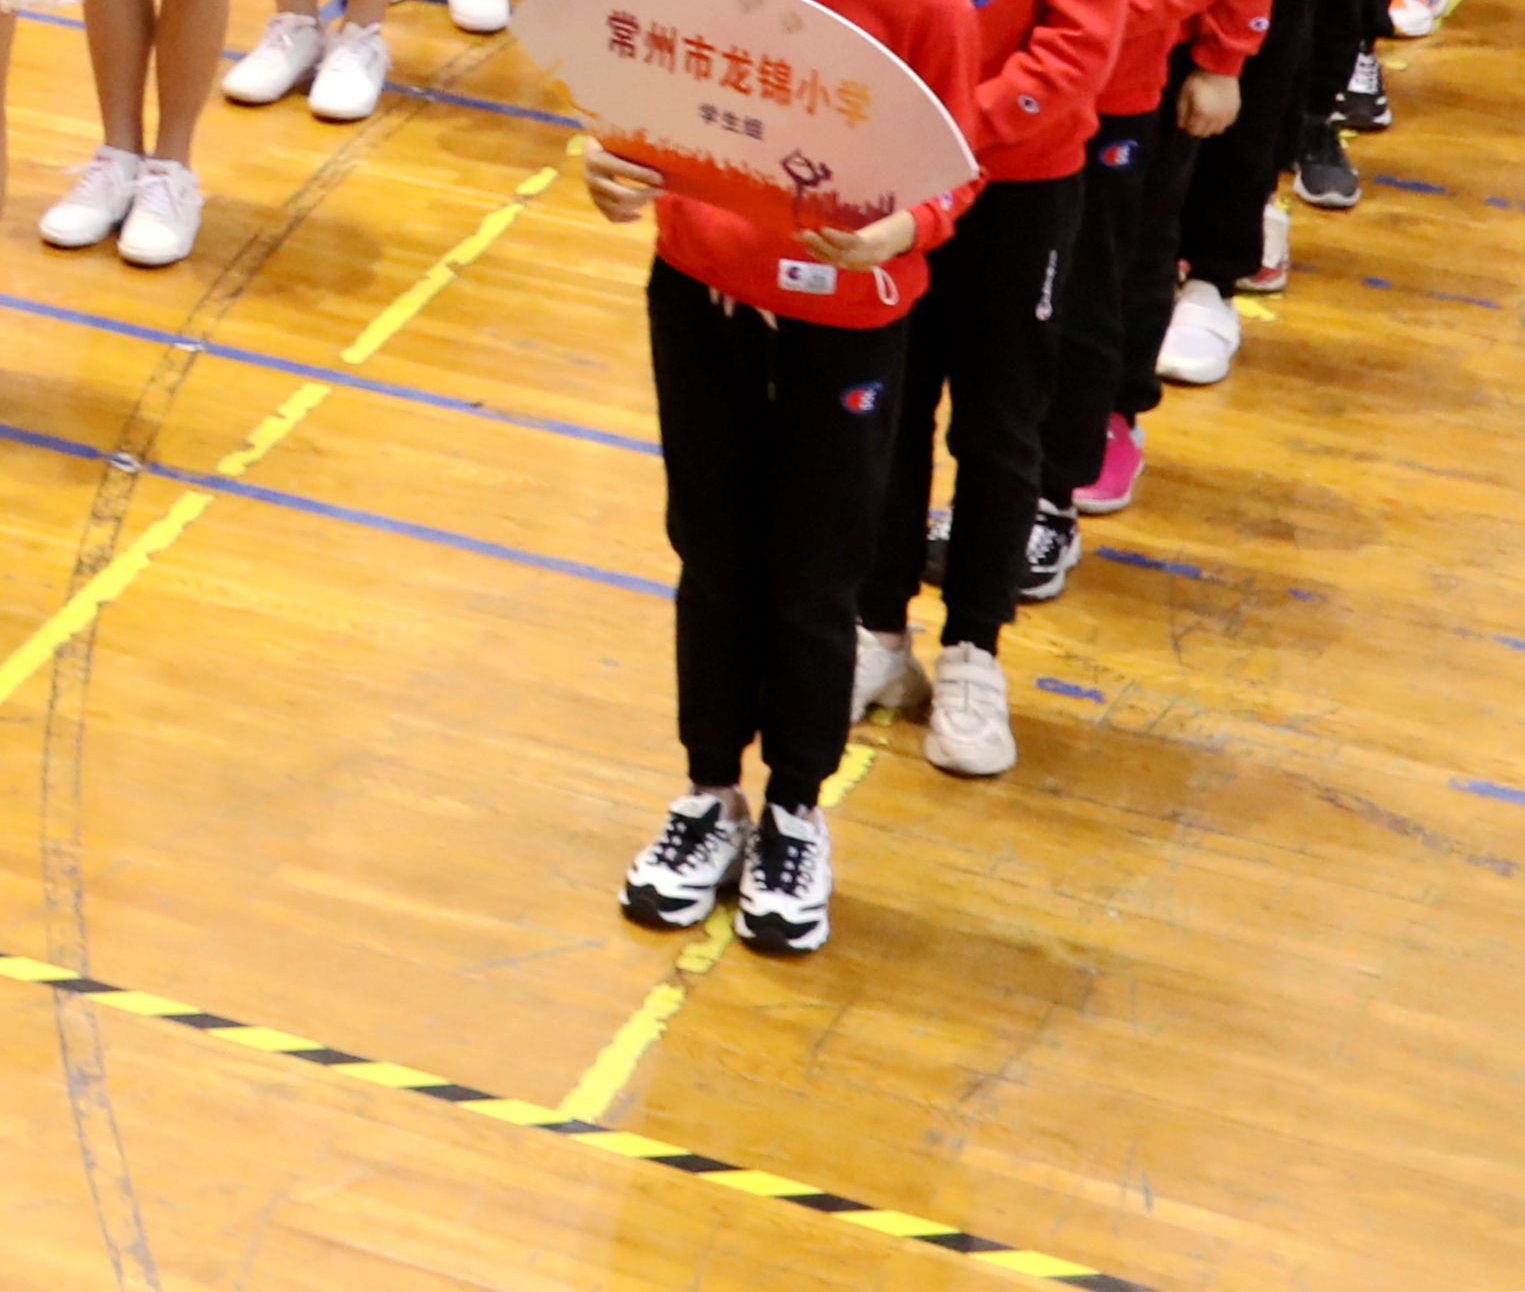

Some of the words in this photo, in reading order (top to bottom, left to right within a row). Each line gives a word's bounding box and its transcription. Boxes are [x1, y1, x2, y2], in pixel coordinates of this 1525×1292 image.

[605, 9, 876, 129] 常州市龙锦小学
[697, 102, 765, 142] 学生组
